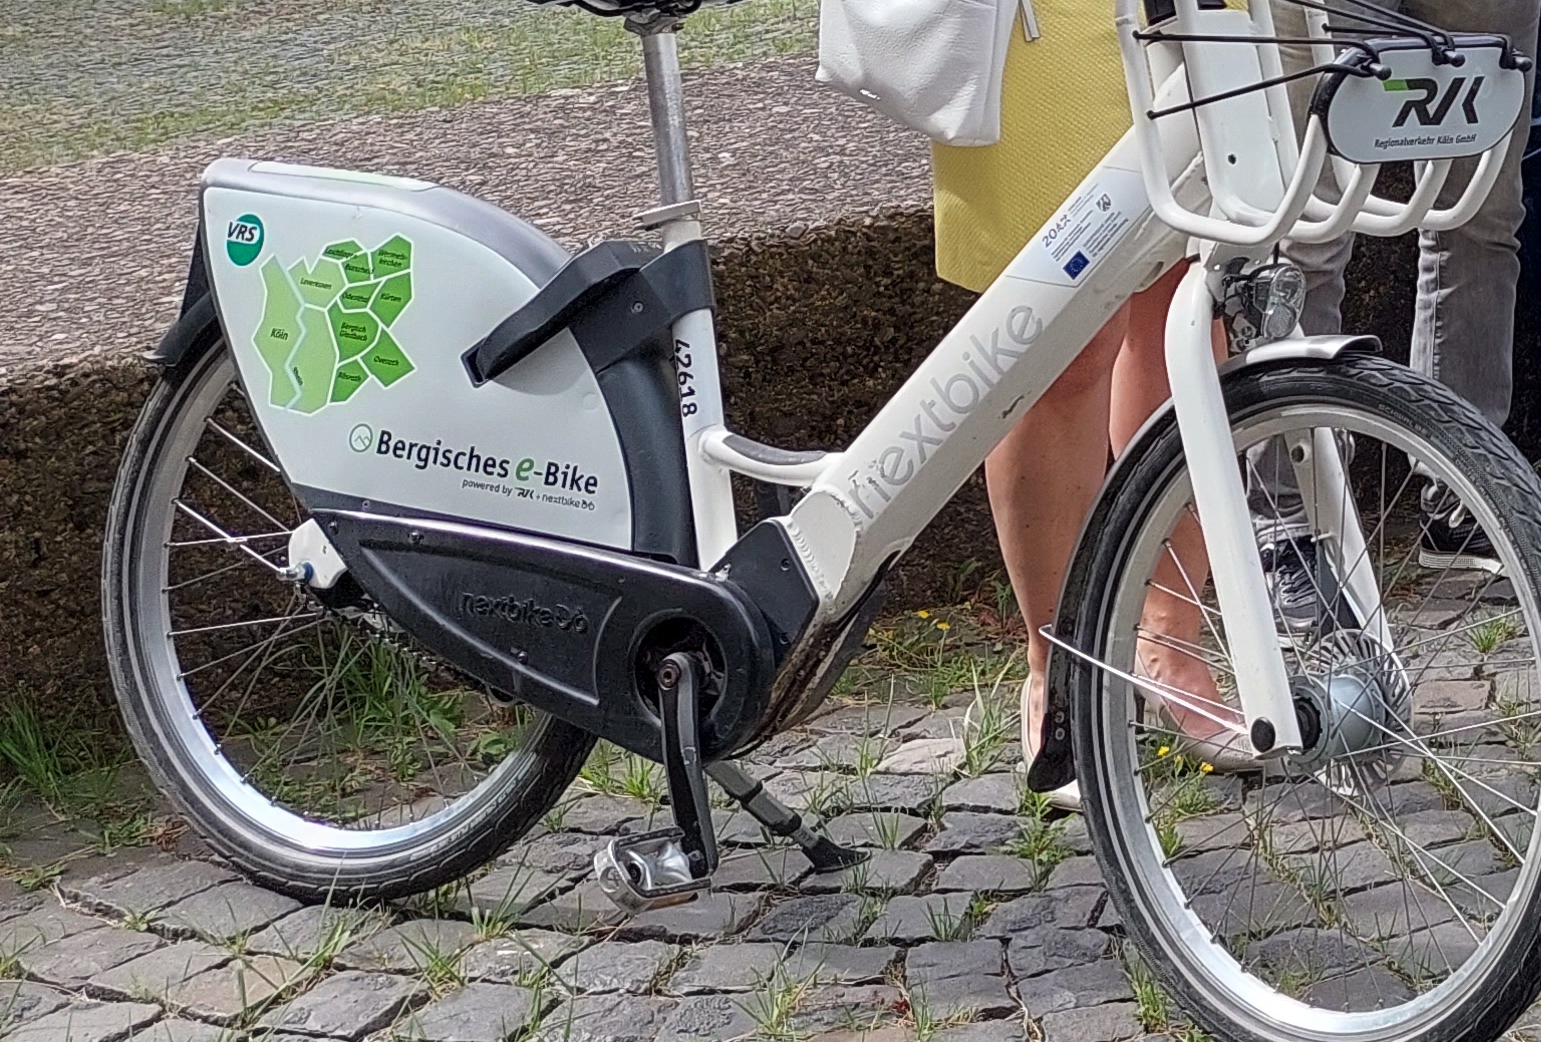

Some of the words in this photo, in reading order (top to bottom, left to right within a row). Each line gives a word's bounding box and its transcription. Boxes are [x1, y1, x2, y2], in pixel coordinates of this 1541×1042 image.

[1374, 136, 1435, 149] Regionalverkehr
[1437, 135, 1454, 145] Köln
[1456, 134, 1477, 144] GmbH
[227, 222, 258, 242] VRS
[270, 328, 289, 340] Köln
[674, 339, 698, 418] 42618
[848, 305, 1043, 519] nextbike
[376, 430, 510, 478] Bergisches
[515, 458, 598, 495] e-Bike
[462, 479, 500, 493] powered
[502, 484, 513, 497] by
[541, 493, 581, 508] nextbike
